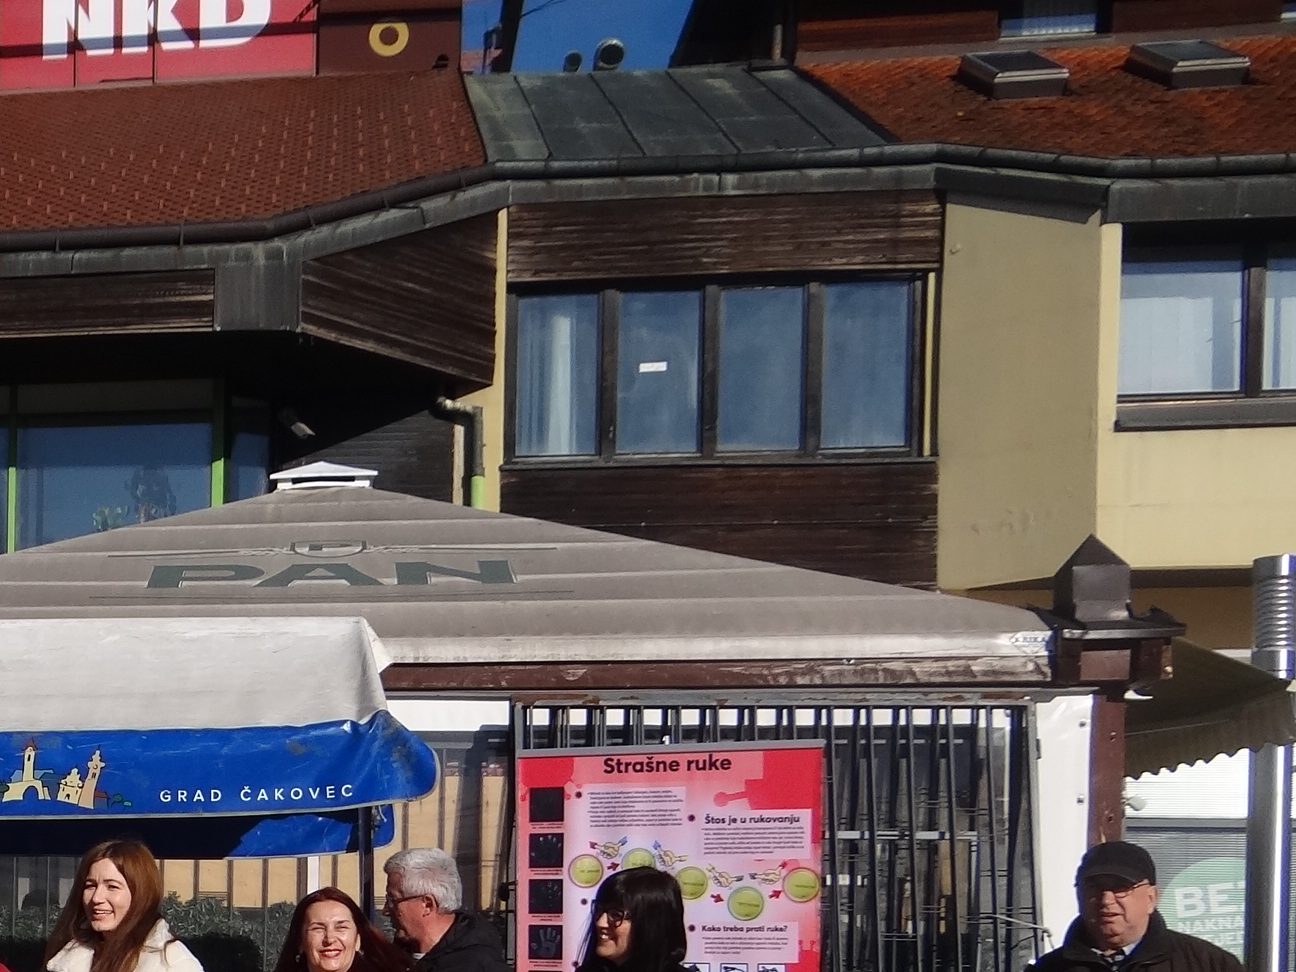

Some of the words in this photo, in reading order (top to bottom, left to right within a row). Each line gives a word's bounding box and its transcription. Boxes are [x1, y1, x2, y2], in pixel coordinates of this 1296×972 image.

[42, 0, 270, 60] NKD
[146, 560, 516, 589] PAN
[603, 756, 680, 774] Strašne
[687, 754, 732, 771] ruke
[159, 789, 222, 803] GRAD
[240, 784, 353, 802] ČAKOVEC
[704, 813, 726, 825] Štos
[727, 815, 738, 826] je
[749, 814, 801, 825] rukovanju
[723, 924, 744, 932] treba
[746, 925, 765, 933] prati
[766, 924, 788, 932] ruke?
